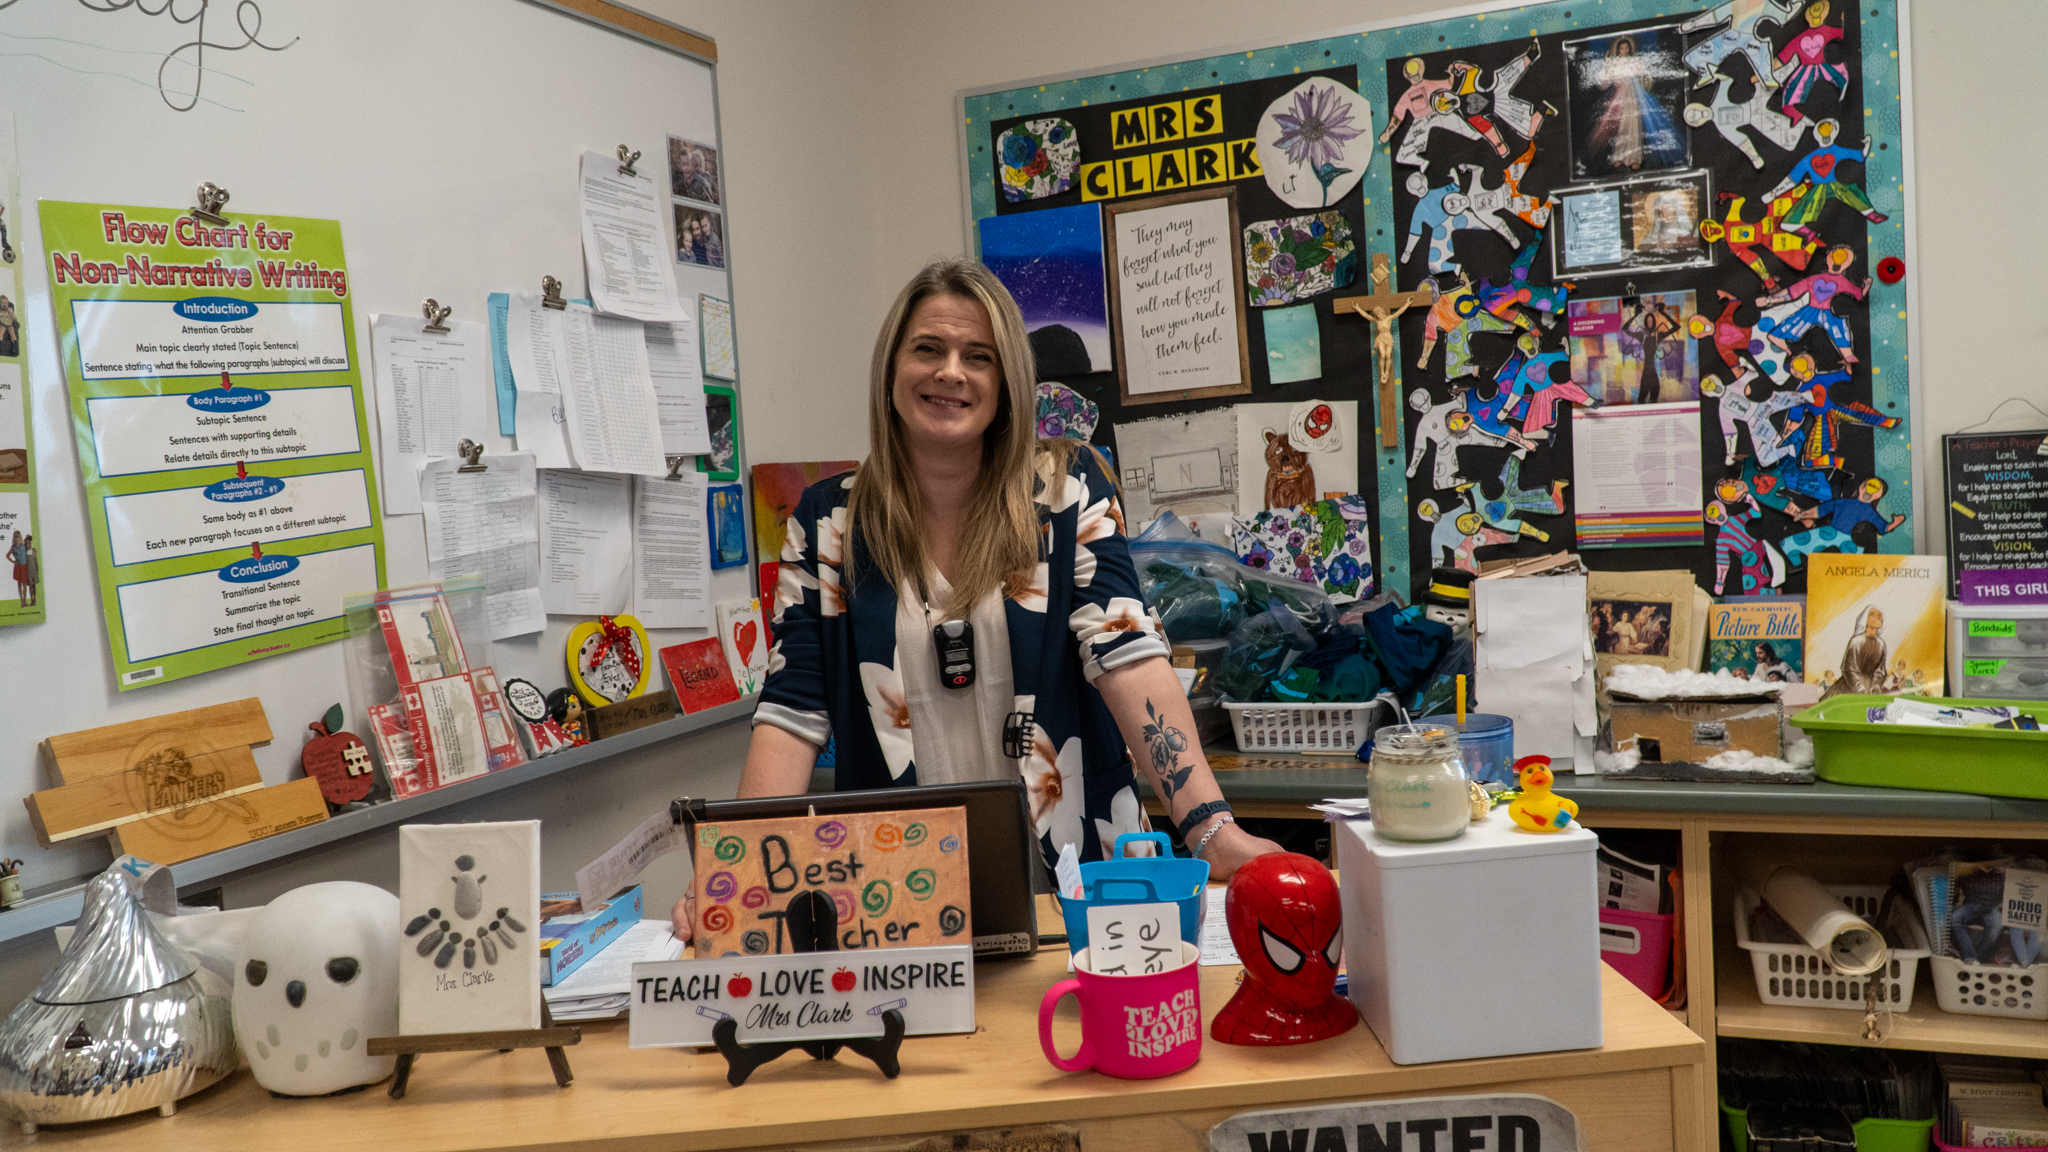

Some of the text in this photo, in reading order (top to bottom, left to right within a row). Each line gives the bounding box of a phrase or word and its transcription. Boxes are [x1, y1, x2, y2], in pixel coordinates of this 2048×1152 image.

[1115, 98, 1214, 146] MRS
[1086, 141, 1260, 197] CLARK
[102, 212, 293, 251] Flow Chart for
[1131, 217, 1193, 245] They may
[1123, 236, 1218, 277] forget what you
[53, 252, 347, 297] Non-Narrative Writing
[1136, 261, 1213, 292] said but they
[1136, 278, 1224, 315] will not forget
[183, 303, 248, 314] Introduction
[182, 325, 254, 334] Attention Grabber
[1141, 300, 1229, 339] how you made
[136, 341, 299, 354] Main topic clearly stated (Topic Sentence)
[1155, 327, 1222, 359] them feel.
[84, 356, 345, 373] Sentence stating following paragraphs (subtopics) discuss
[193, 395, 253, 406] Body Paragraph
[196, 414, 267, 426] Subtopic Sentence
[169, 427, 297, 446] Sentences supporting details
[164, 443, 307, 464] Relate details directly subtopic
[1179, 462, 1194, 484] N
[1963, 460, 2038, 472] Enable teach
[1984, 470, 2034, 481] WISDOM,
[211, 488, 253, 501] Paragraphs
[222, 479, 264, 491] Subsequent
[2002, 481, 2026, 492] shape
[1966, 490, 2038, 504] Equip teach
[203, 505, 293, 524] Same above
[2023, 511, 2047, 521] shape
[146, 513, 347, 550] Each paragraph focuses different subtopic
[1960, 532, 2001, 542] Encourage
[1993, 541, 2035, 551] VISION,
[2004, 551, 2028, 562] shape
[230, 560, 288, 578] Conclusion
[1825, 566, 1930, 579] ANGELA MERICI
[1964, 562, 2000, 570] Empower
[221, 579, 301, 599] Transitional Sentence
[1974, 584, 2010, 597] THIS
[225, 594, 301, 616] Summarize topic
[213, 608, 315, 637] State final thought topic
[1716, 611, 1800, 636] Picture Bible
[678, 666, 718, 689] LEGEND
[416, 720, 434, 789] Governor General
[148, 772, 226, 810] LANCERS
[760, 834, 865, 893] Best
[2007, 910, 2041, 924] SAFETY
[2008, 899, 2042, 914] DRUG
[757, 910, 920, 953] Tcher
[1101, 920, 1124, 951] in
[435, 975, 457, 991] Mrs
[637, 961, 966, 1003] TEACH LOVE INSPIRE
[745, 1001, 854, 1030] Mrs Clark
[1123, 988, 1195, 1027] TEACH
[1134, 1010, 1194, 1042] LOVE
[1128, 1025, 1197, 1058] INSPIRE
